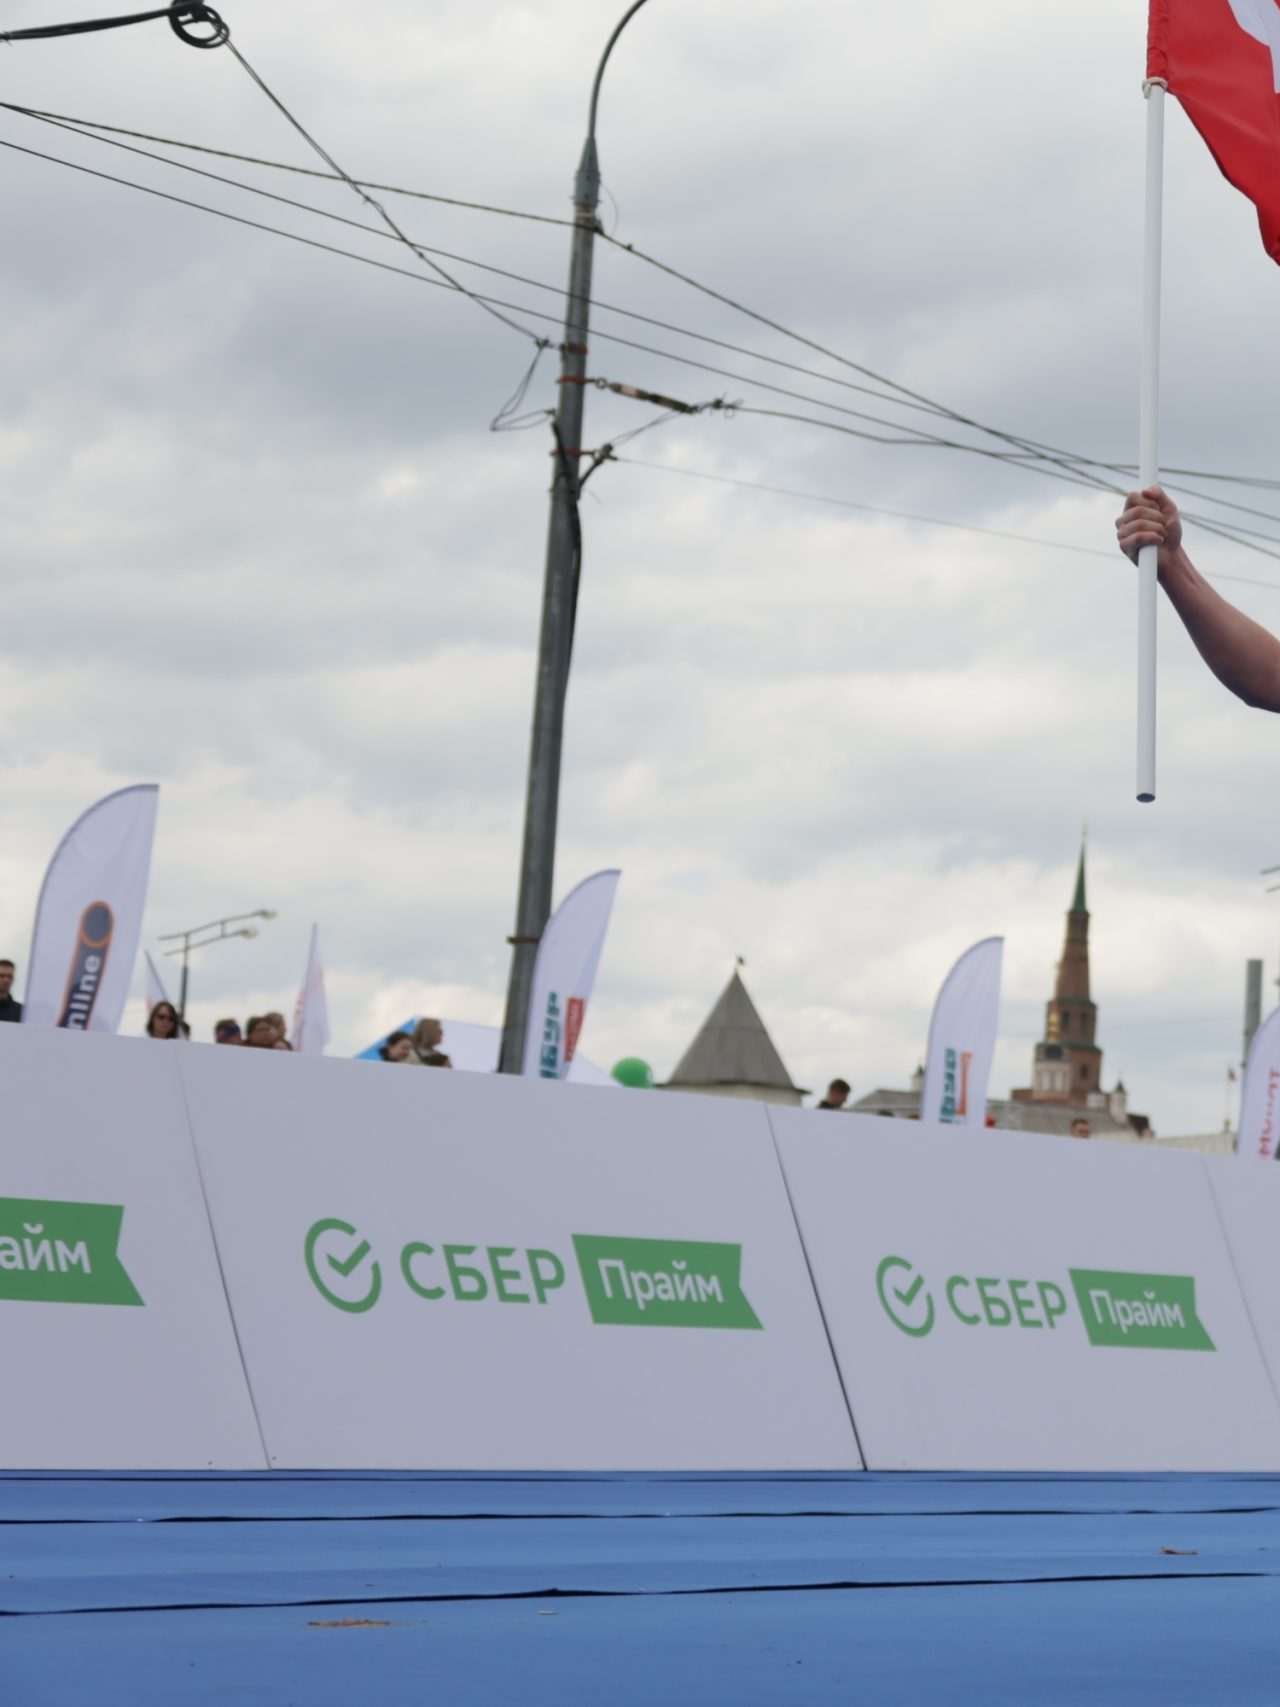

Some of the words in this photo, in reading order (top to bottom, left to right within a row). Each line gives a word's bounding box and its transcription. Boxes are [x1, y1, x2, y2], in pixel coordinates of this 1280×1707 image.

[68, 955, 101, 1029] nline
[0, 1222, 92, 1274] айм
[400, 1241, 566, 1304] СБЕР
[598, 1258, 725, 1310] Прайм
[945, 1275, 1068, 1329] СБЕР
[1088, 1289, 1186, 1334] Прайм
